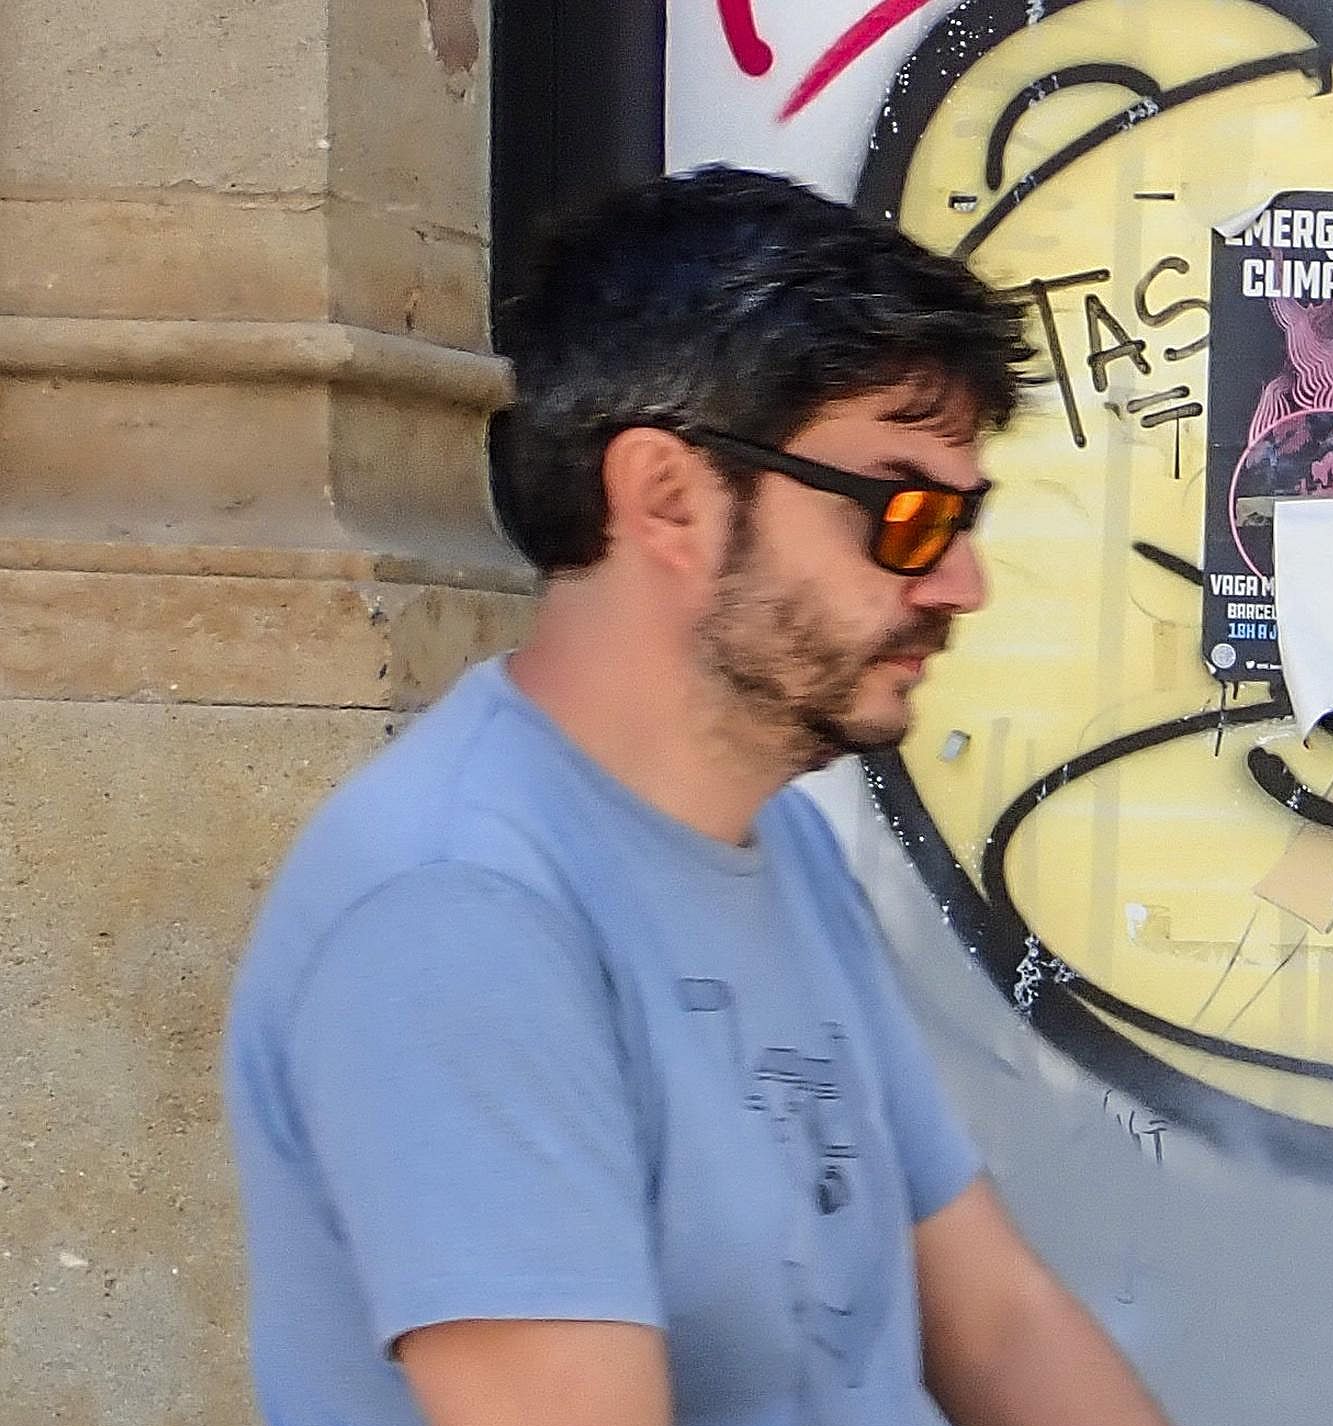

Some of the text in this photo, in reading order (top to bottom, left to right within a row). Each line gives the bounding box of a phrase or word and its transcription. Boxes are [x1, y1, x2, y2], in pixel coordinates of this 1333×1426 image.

[1210, 574, 1258, 596] VAGA
[1227, 603, 1278, 620] BARCEL
[1258, 624, 1267, 639] A
